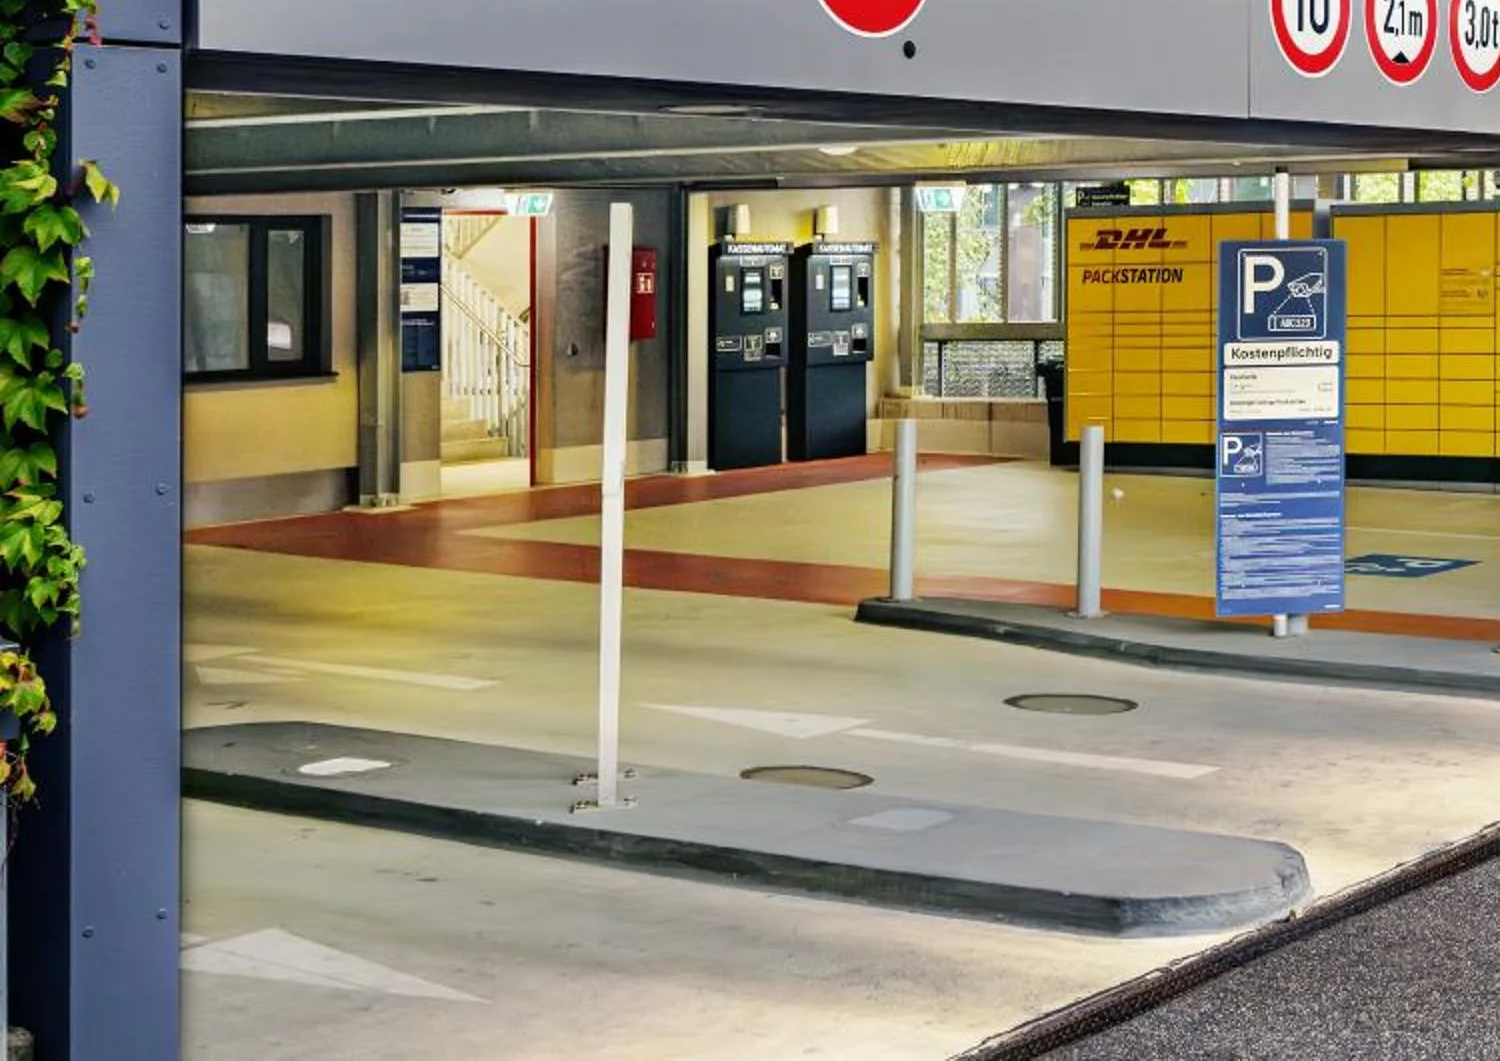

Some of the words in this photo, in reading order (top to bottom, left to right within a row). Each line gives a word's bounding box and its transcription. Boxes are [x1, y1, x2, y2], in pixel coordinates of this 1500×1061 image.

[1094, 228, 1170, 250] DHL
[1081, 267, 1185, 285] PACKSTATION
[1243, 254, 1285, 315] P
[1231, 346, 1333, 361] Kostenpflichtig
[1223, 436, 1242, 467] P
